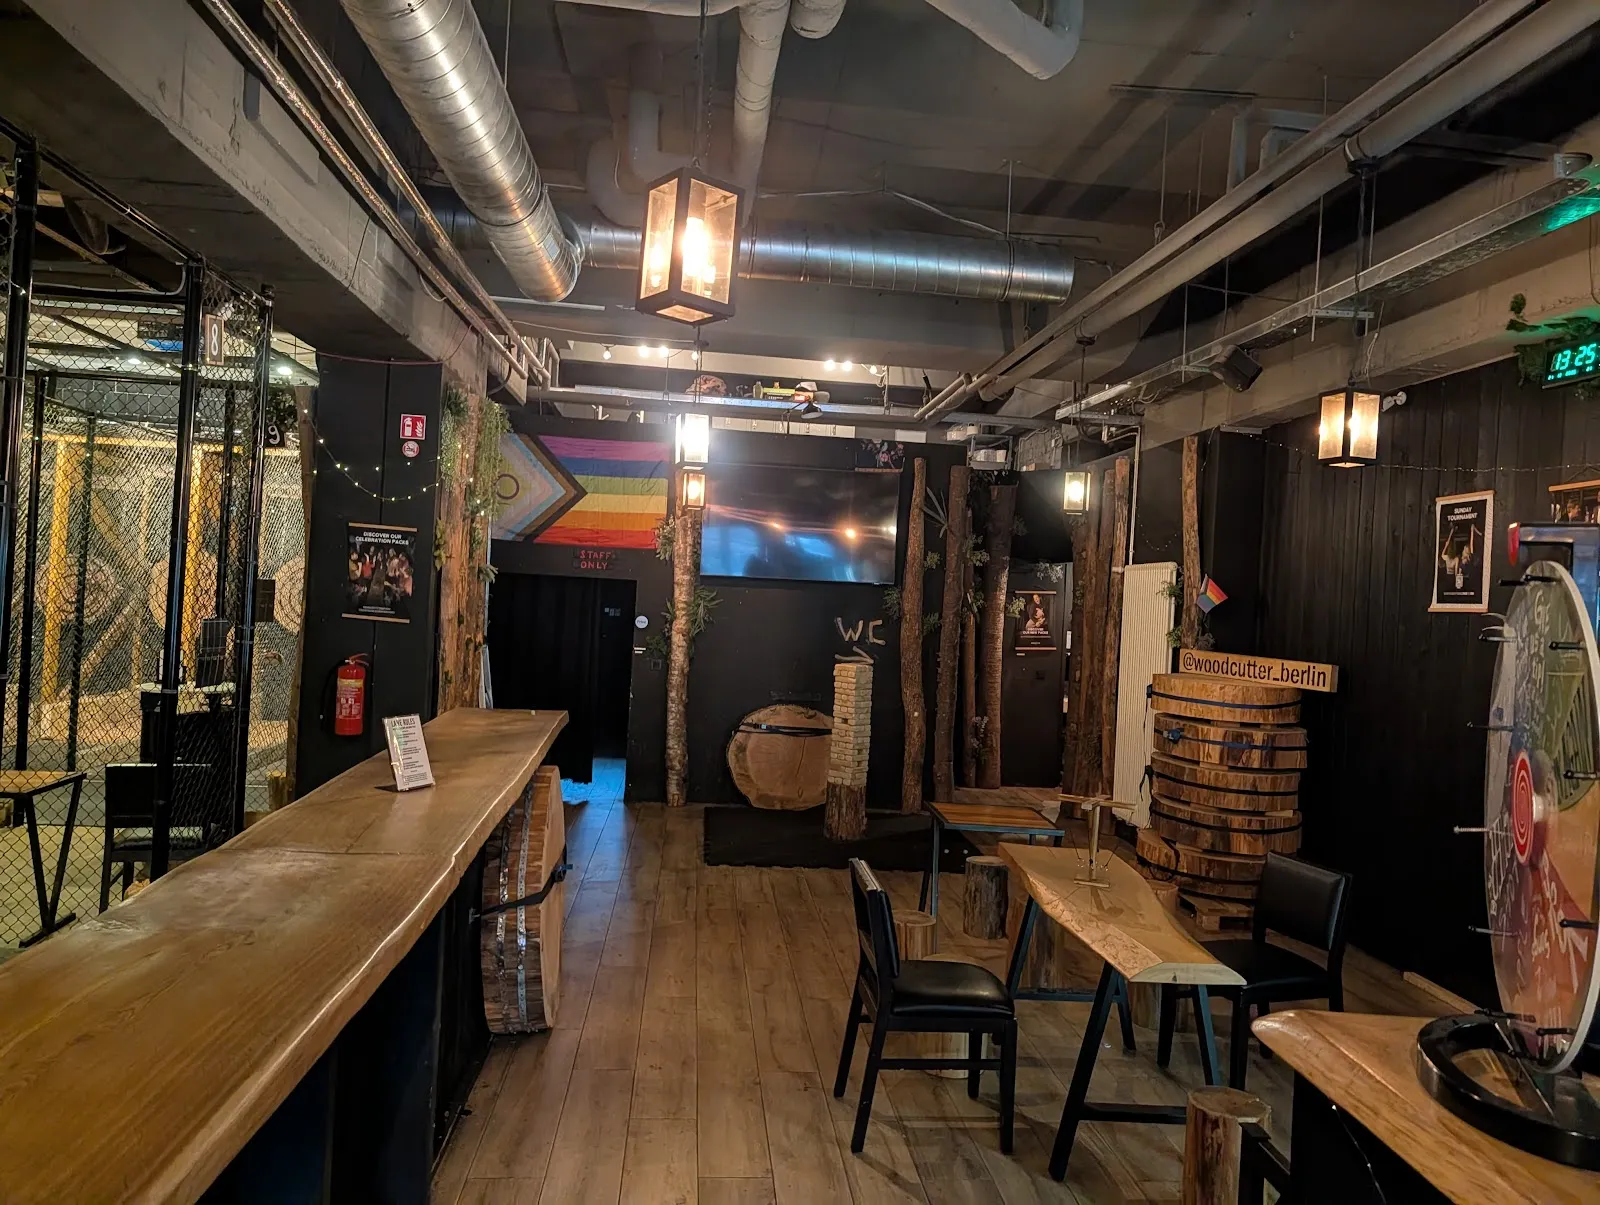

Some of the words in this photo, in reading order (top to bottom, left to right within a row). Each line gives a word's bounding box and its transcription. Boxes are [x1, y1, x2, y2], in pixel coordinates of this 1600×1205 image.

[208, 323, 219, 356] 8
[267, 425, 280, 445] 9
[1447, 512, 1478, 521] TOURNAMENT
[1453, 506, 1473, 514] SUNDAY
[580, 550, 612, 560] STAFF
[580, 561, 608, 570] ONLY
[834, 617, 886, 645] WC
[1183, 652, 1326, 687] @woodcutter_berlin
